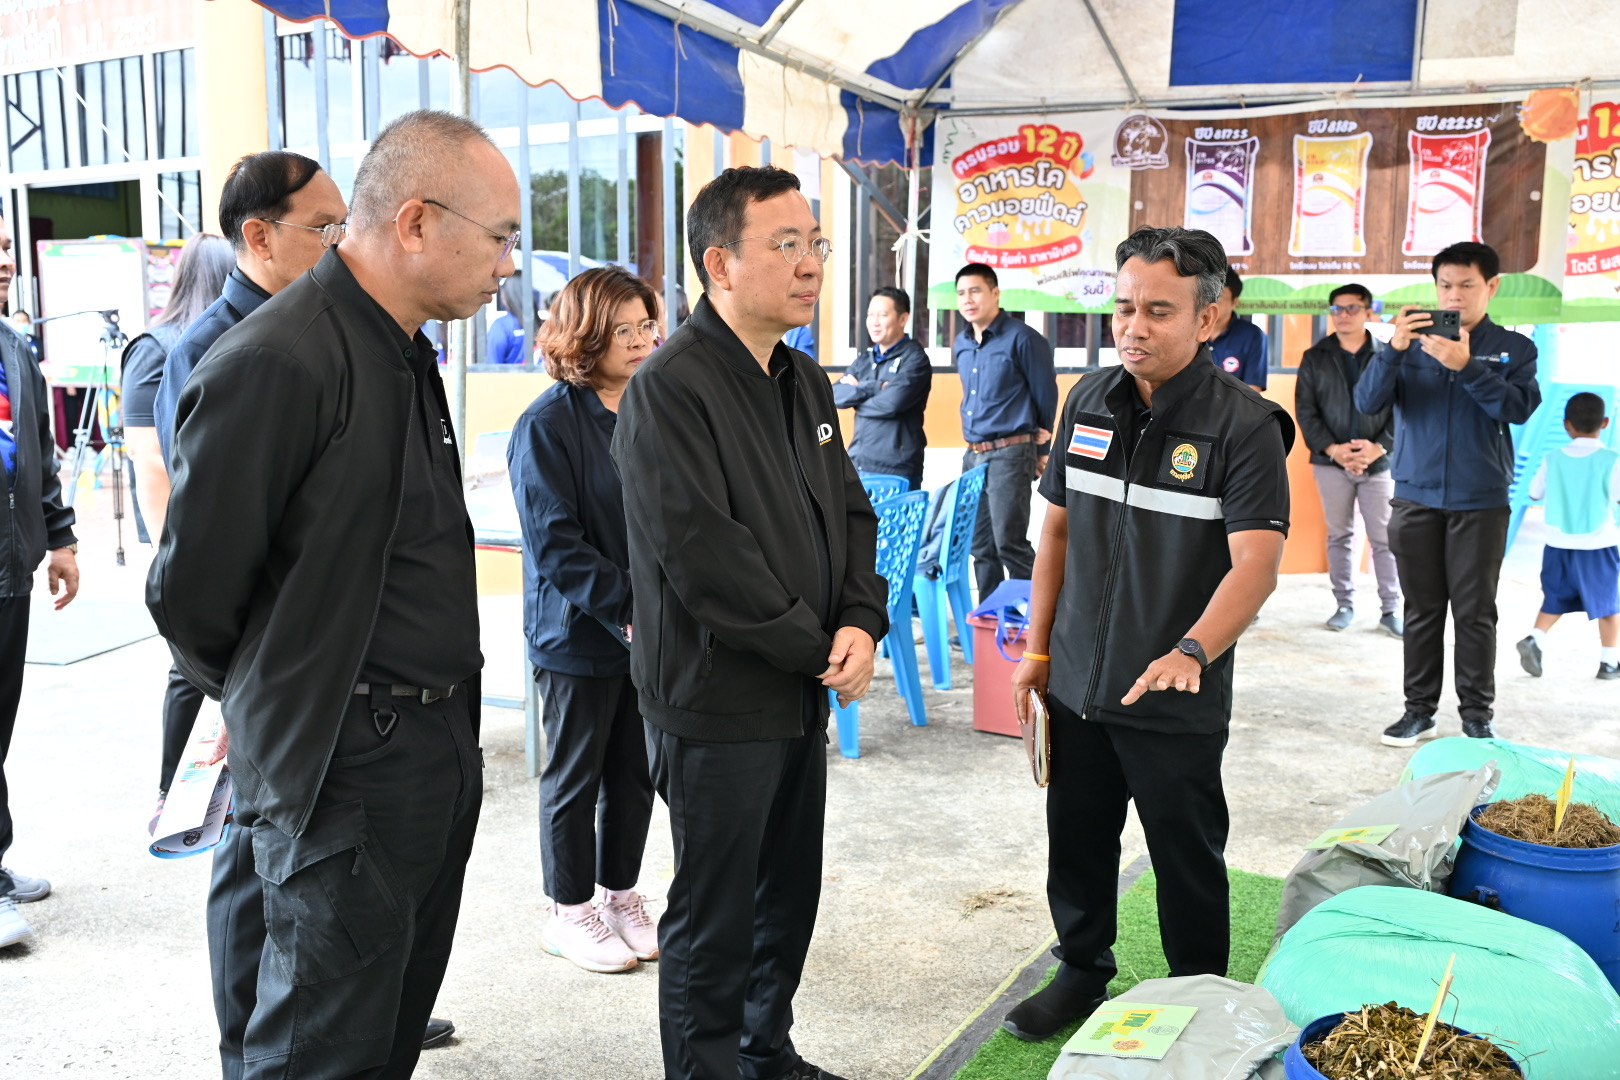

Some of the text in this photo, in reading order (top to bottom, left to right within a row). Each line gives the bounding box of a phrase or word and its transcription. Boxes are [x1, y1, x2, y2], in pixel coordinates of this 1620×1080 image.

[955, 128, 1080, 175] ครบรอบ 12 ปี
[958, 159, 1065, 204] อาหารโค
[954, 191, 1088, 234] คาวบอยฟีดส์
[1122, 1013, 1152, 1028] TMR
